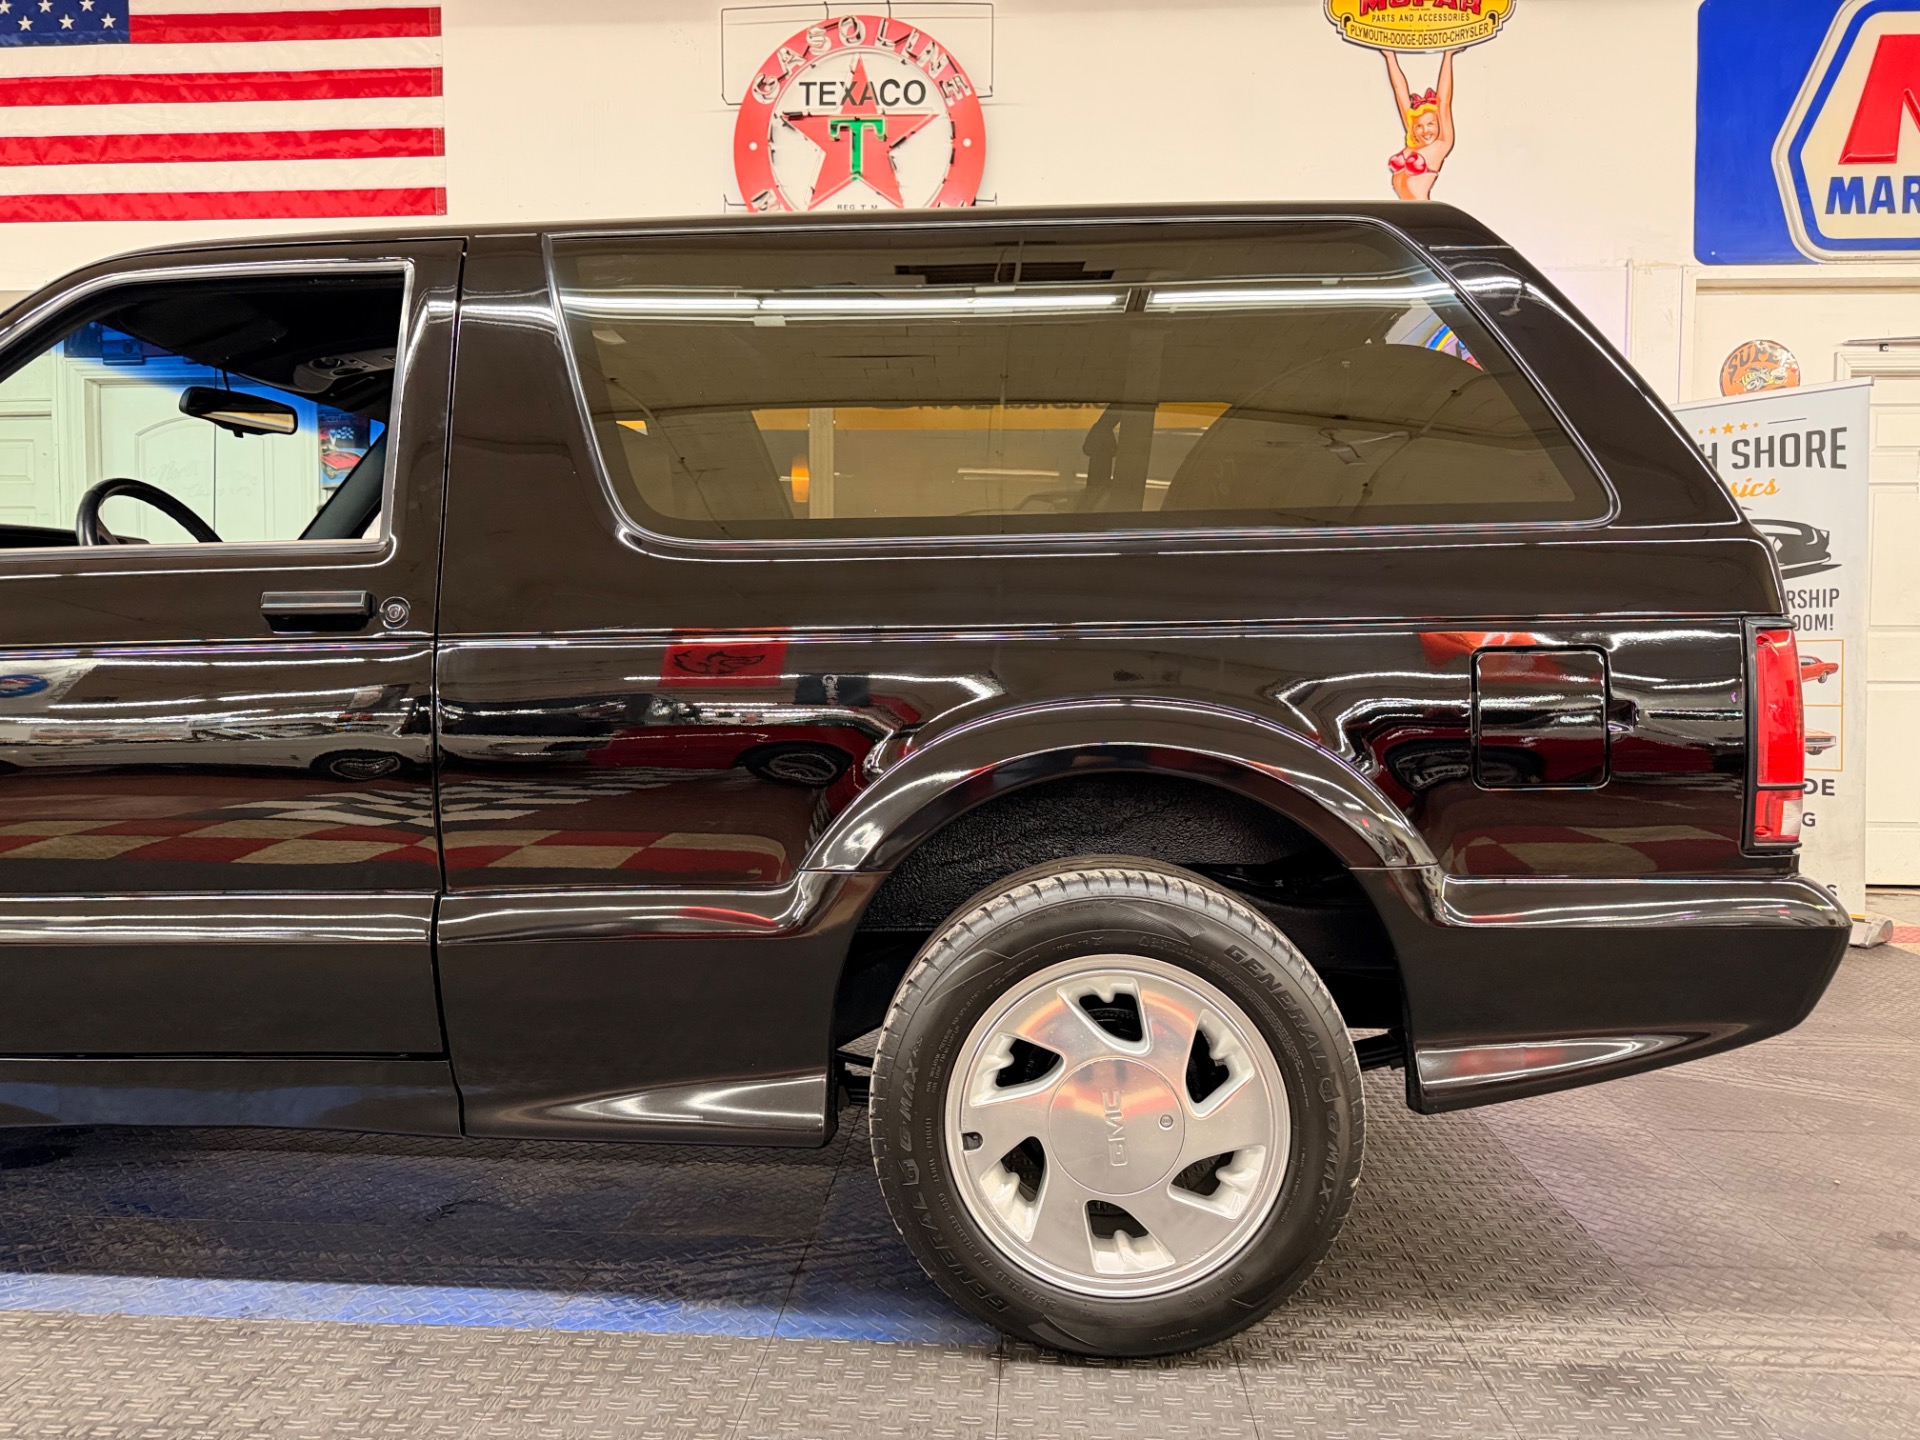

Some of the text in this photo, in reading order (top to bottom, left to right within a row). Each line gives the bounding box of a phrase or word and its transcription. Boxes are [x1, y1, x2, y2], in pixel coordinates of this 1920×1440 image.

[1350, 22, 1489, 46] PLYMOUTH-DODGE-DESOTO-CHRYSLER
[1372, 13, 1470, 22] PARTS AND ACCESSORIES
[752, 15, 972, 107] GASOLINE
[799, 78, 927, 107] TEXACO
[1731, 427, 1847, 470] SHORE
[1785, 613, 1834, 631] OOM!
[1223, 944, 1326, 1070] GENERAL
[1101, 1087, 1128, 1167] GMC
